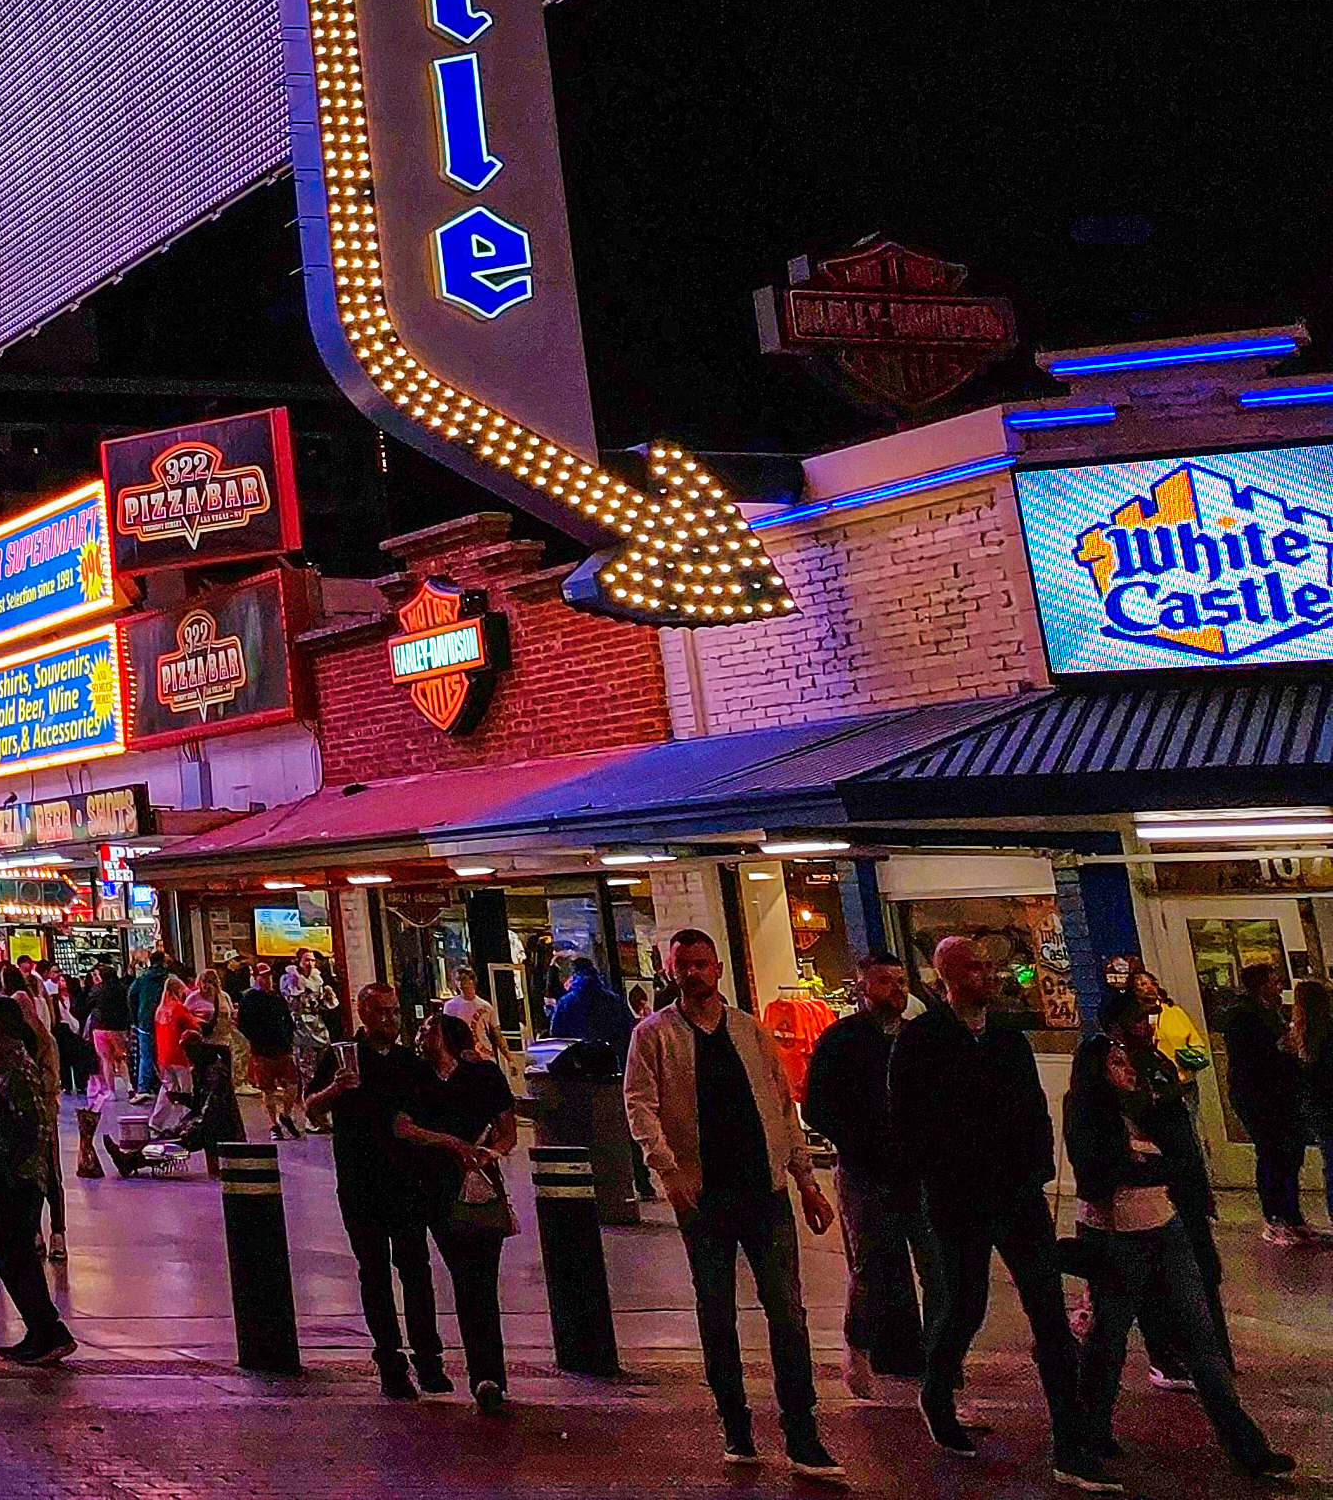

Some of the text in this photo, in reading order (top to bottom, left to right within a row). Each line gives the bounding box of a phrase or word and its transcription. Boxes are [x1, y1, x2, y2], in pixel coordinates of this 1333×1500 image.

[165, 453, 209, 485] 322
[124, 476, 260, 525] PIZZA BAR
[4, 504, 100, 578] SUPERMART
[1106, 522, 1312, 583] White
[6, 585, 37, 611] Selection
[38, 578, 55, 600] since
[56, 567, 75, 591] 1991
[407, 590, 454, 632] MOTOR
[1104, 571, 1333, 632] Castle
[184, 621, 208, 654] 322
[393, 626, 480, 677] HARLEY-DAVIDSON
[161, 647, 240, 694] PIZZA BAR
[18, 698, 46, 723] Beer,
[48, 686, 79, 716] Wine
[416, 673, 463, 722] CYCLES
[32, 710, 102, 750] Accessories
[34, 800, 74, 844] BEER
[86, 788, 137, 838] SHOTS
